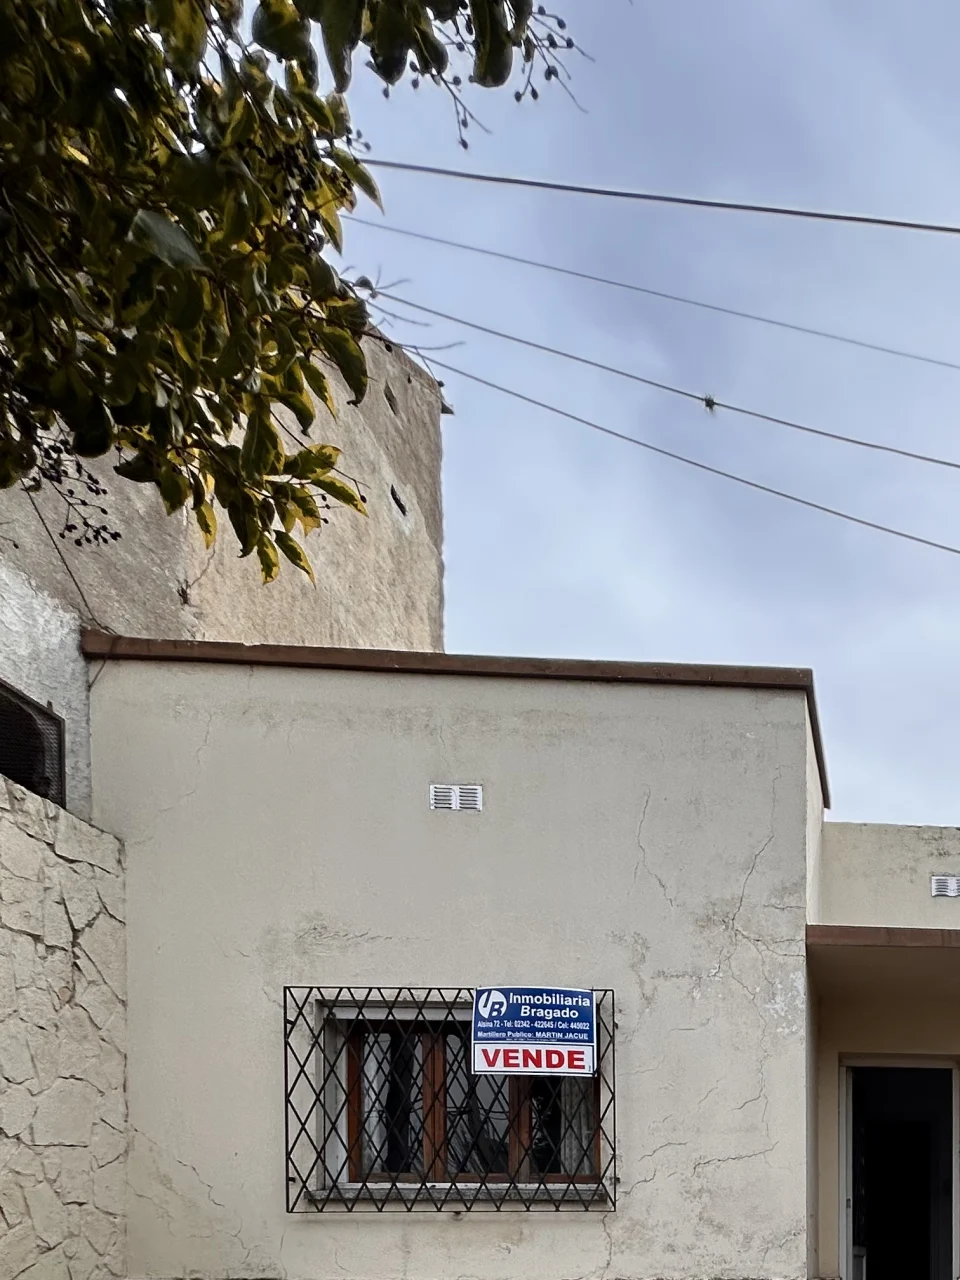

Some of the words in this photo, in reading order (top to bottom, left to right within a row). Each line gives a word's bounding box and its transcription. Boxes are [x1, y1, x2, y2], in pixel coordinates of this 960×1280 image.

[509, 992, 591, 1007] Inmobiliaria
[520, 1005, 579, 1020] Bragado
[477, 1020, 493, 1028] Alsina
[493, 1020, 501, 1028] 72
[504, 1020, 514, 1028] Tel:
[514, 1020, 531, 1028] 02342
[557, 1021, 569, 1029] Cel:
[481, 1048, 586, 1070] VENDE
